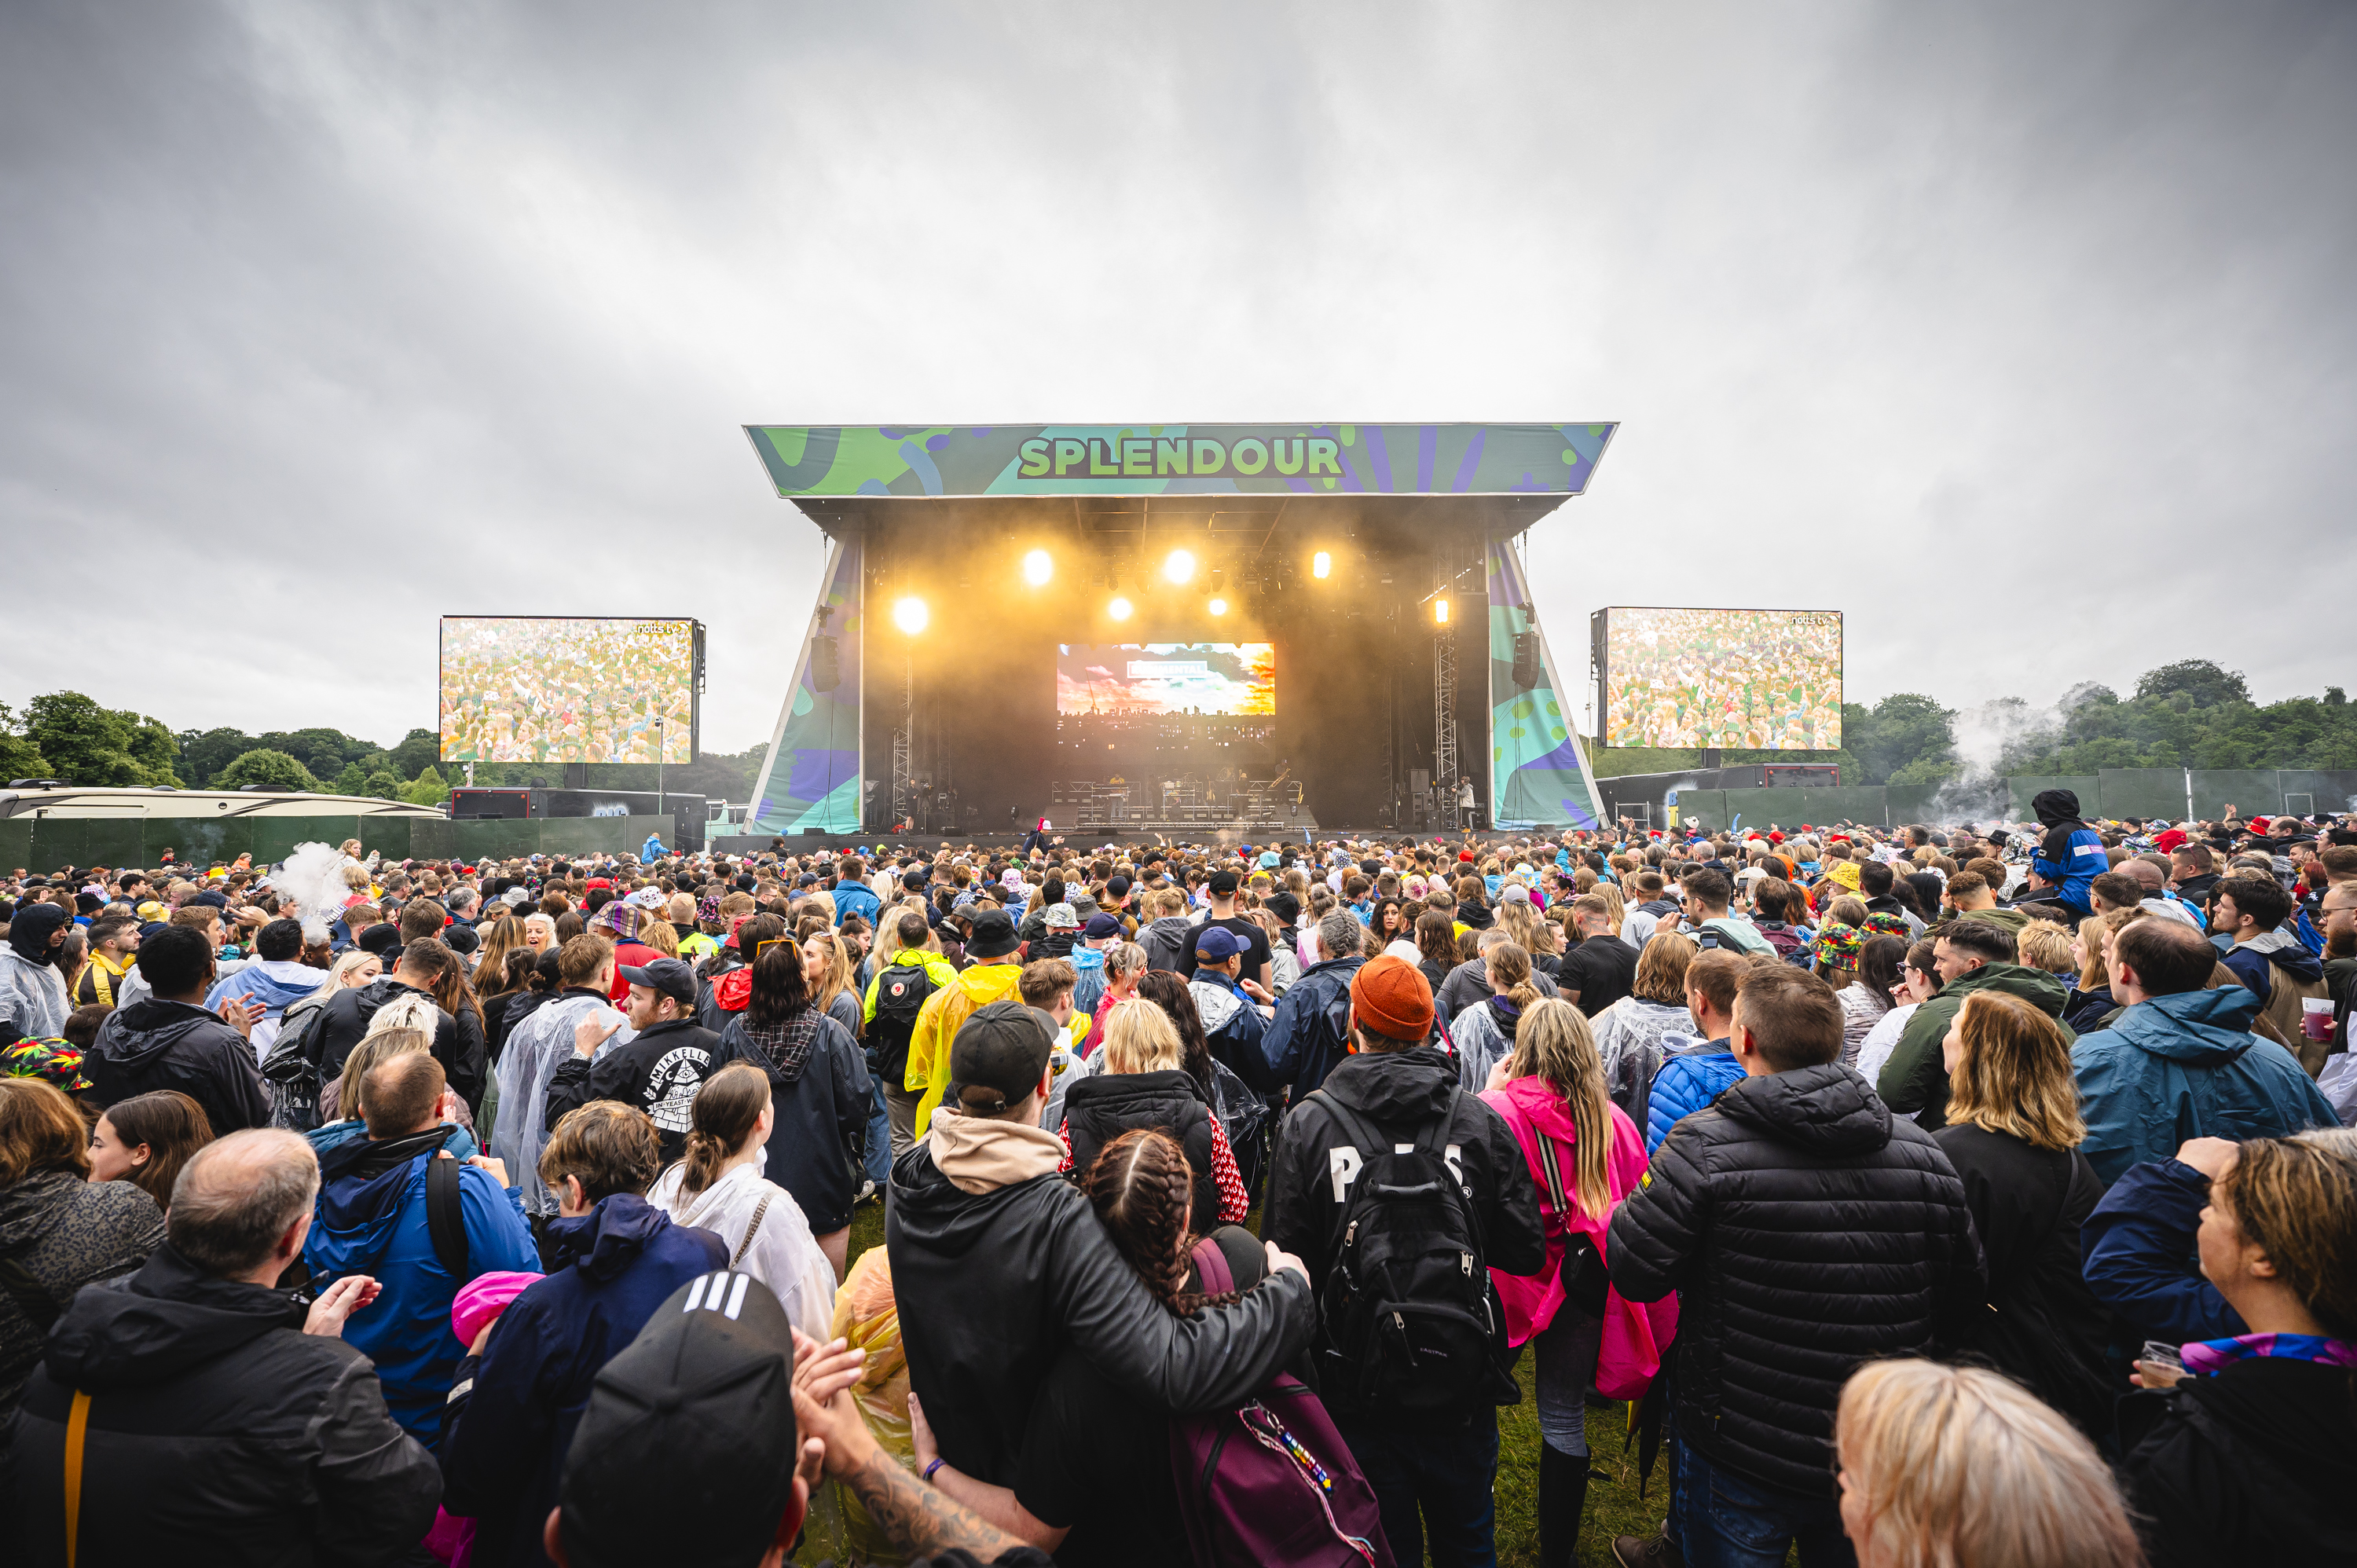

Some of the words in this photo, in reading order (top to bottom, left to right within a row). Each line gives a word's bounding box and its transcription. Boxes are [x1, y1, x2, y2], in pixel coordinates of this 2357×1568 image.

[1020, 438, 1343, 477] SPLENDOUR
[638, 624, 664, 633] notts
[666, 624, 677, 633] tv
[1792, 615, 1816, 625] notts
[1818, 615, 1827, 625] tv
[651, 1049, 711, 1080] MIKKELLE
